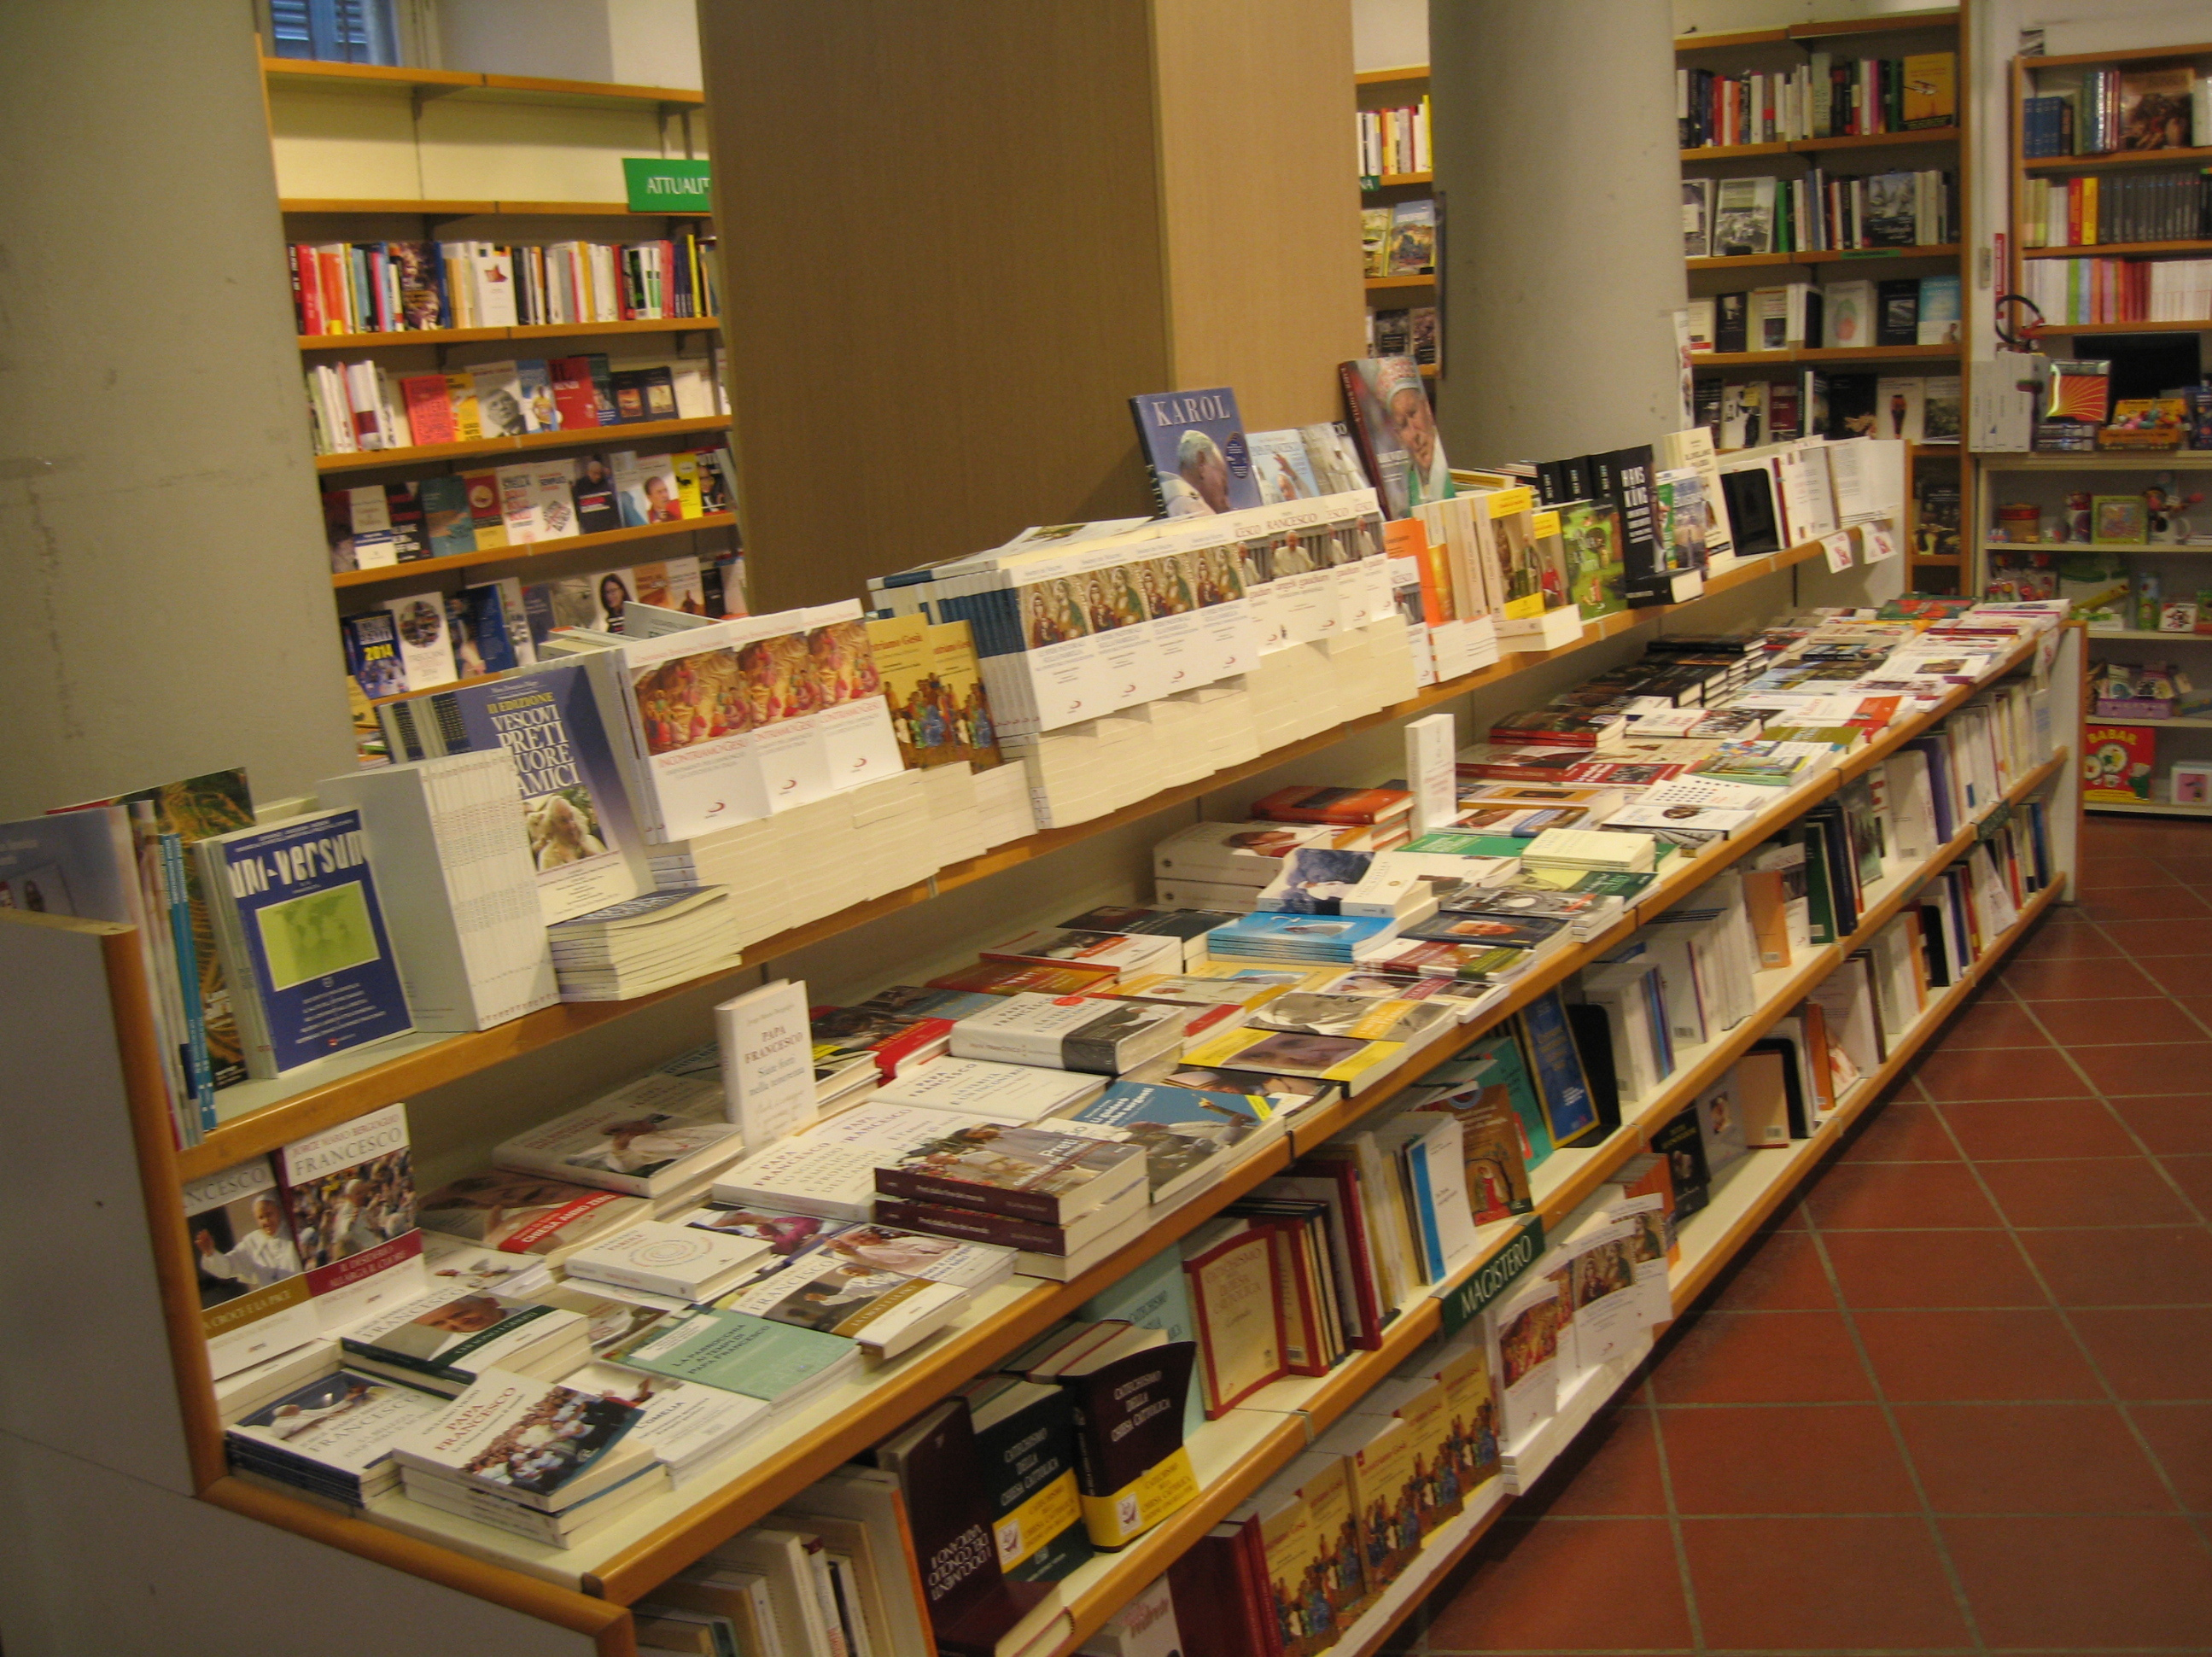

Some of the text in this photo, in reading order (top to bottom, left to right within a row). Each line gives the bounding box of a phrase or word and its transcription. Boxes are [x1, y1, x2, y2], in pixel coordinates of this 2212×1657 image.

[1153, 395, 1231, 427] KAROL
[491, 704, 562, 732] VESCOVI
[496, 721, 569, 754] PRETI
[2087, 729, 2139, 746] BABAR
[514, 744, 575, 774] UORE
[517, 762, 582, 796] AMICI
[744, 1030, 803, 1065] FRANCESCO
[761, 1022, 786, 1044] PAPA
[906, 1063, 980, 1098] FRANCESCO
[914, 1071, 948, 1087] PAPA
[294, 1126, 402, 1176] FRANCESCO
[751, 1141, 832, 1187] FRANCESCO
[762, 1146, 797, 1169] PAPA
[775, 1146, 845, 1185] LO SGUARDO
[796, 1151, 854, 1183] SEMPLICE
[812, 1148, 878, 1185] PROFONDO
[522, 1193, 616, 1245] CHIESA ANNO ZERO
[751, 1259, 837, 1311] FRANCESCO
[1461, 1235, 1532, 1319] MAGISTERO
[672, 1356, 689, 1367] LA
[689, 1324, 746, 1359] PARROCCHIA
[688, 1358, 716, 1374] PAPA
[714, 1325, 772, 1363] FRANCESCO
[1113, 1370, 1162, 1401] CATECHISMO
[310, 1394, 422, 1453] FRANCESCO
[435, 1387, 517, 1451] FRANCESCO
[446, 1403, 484, 1432] PAPA
[633, 1401, 686, 1430] L'OMELIA
[931, 1549, 989, 1601] DOCUMENTI
